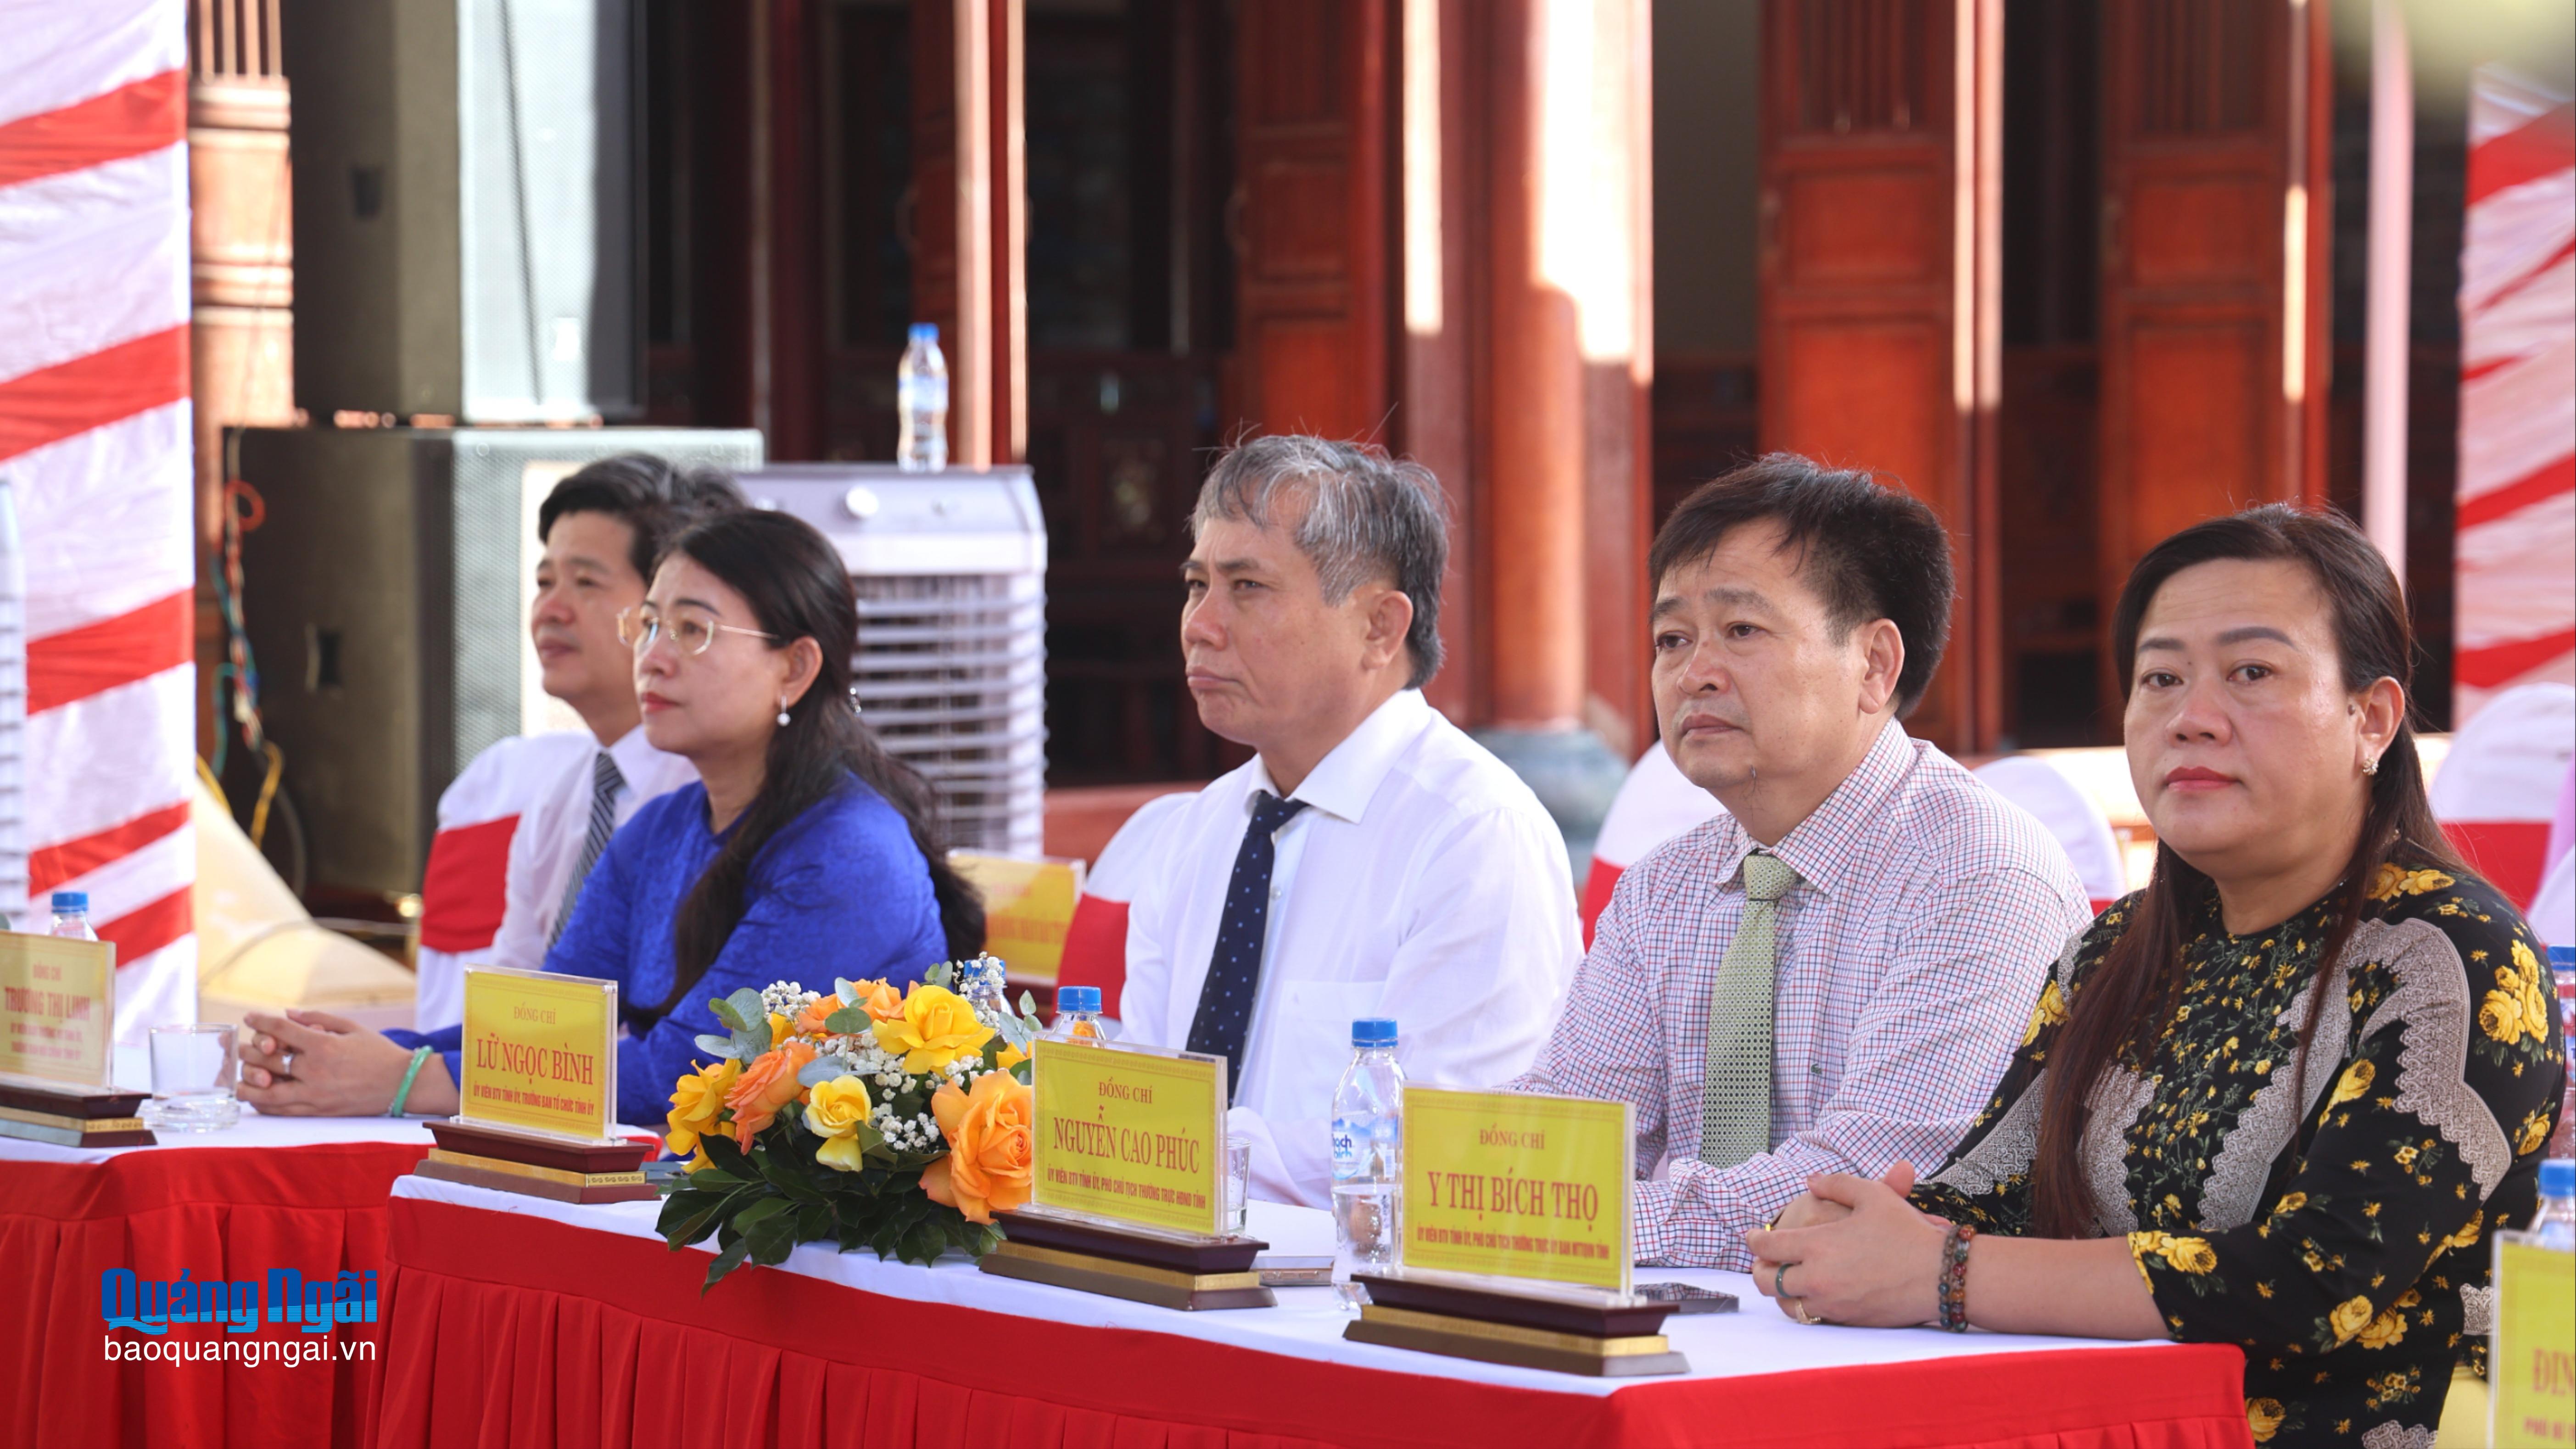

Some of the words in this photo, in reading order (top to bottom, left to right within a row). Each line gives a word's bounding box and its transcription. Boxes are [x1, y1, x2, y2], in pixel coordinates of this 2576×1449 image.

[502, 1042, 548, 1084] NGỌC
[552, 1042, 593, 1085] BÌNH
[1133, 1085, 1152, 1104] CHÍ
[1054, 1105, 1117, 1159] NGUYỄN
[1121, 1128, 1151, 1165] CAO
[1156, 1127, 1200, 1174] PHÚC
[1521, 1130, 1545, 1149] CHÍ
[1427, 1171, 1442, 1206] Y
[1447, 1173, 1485, 1221] THỊ
[1491, 1166, 1545, 1217] BÍCH
[1551, 1182, 1598, 1232] THỌ
